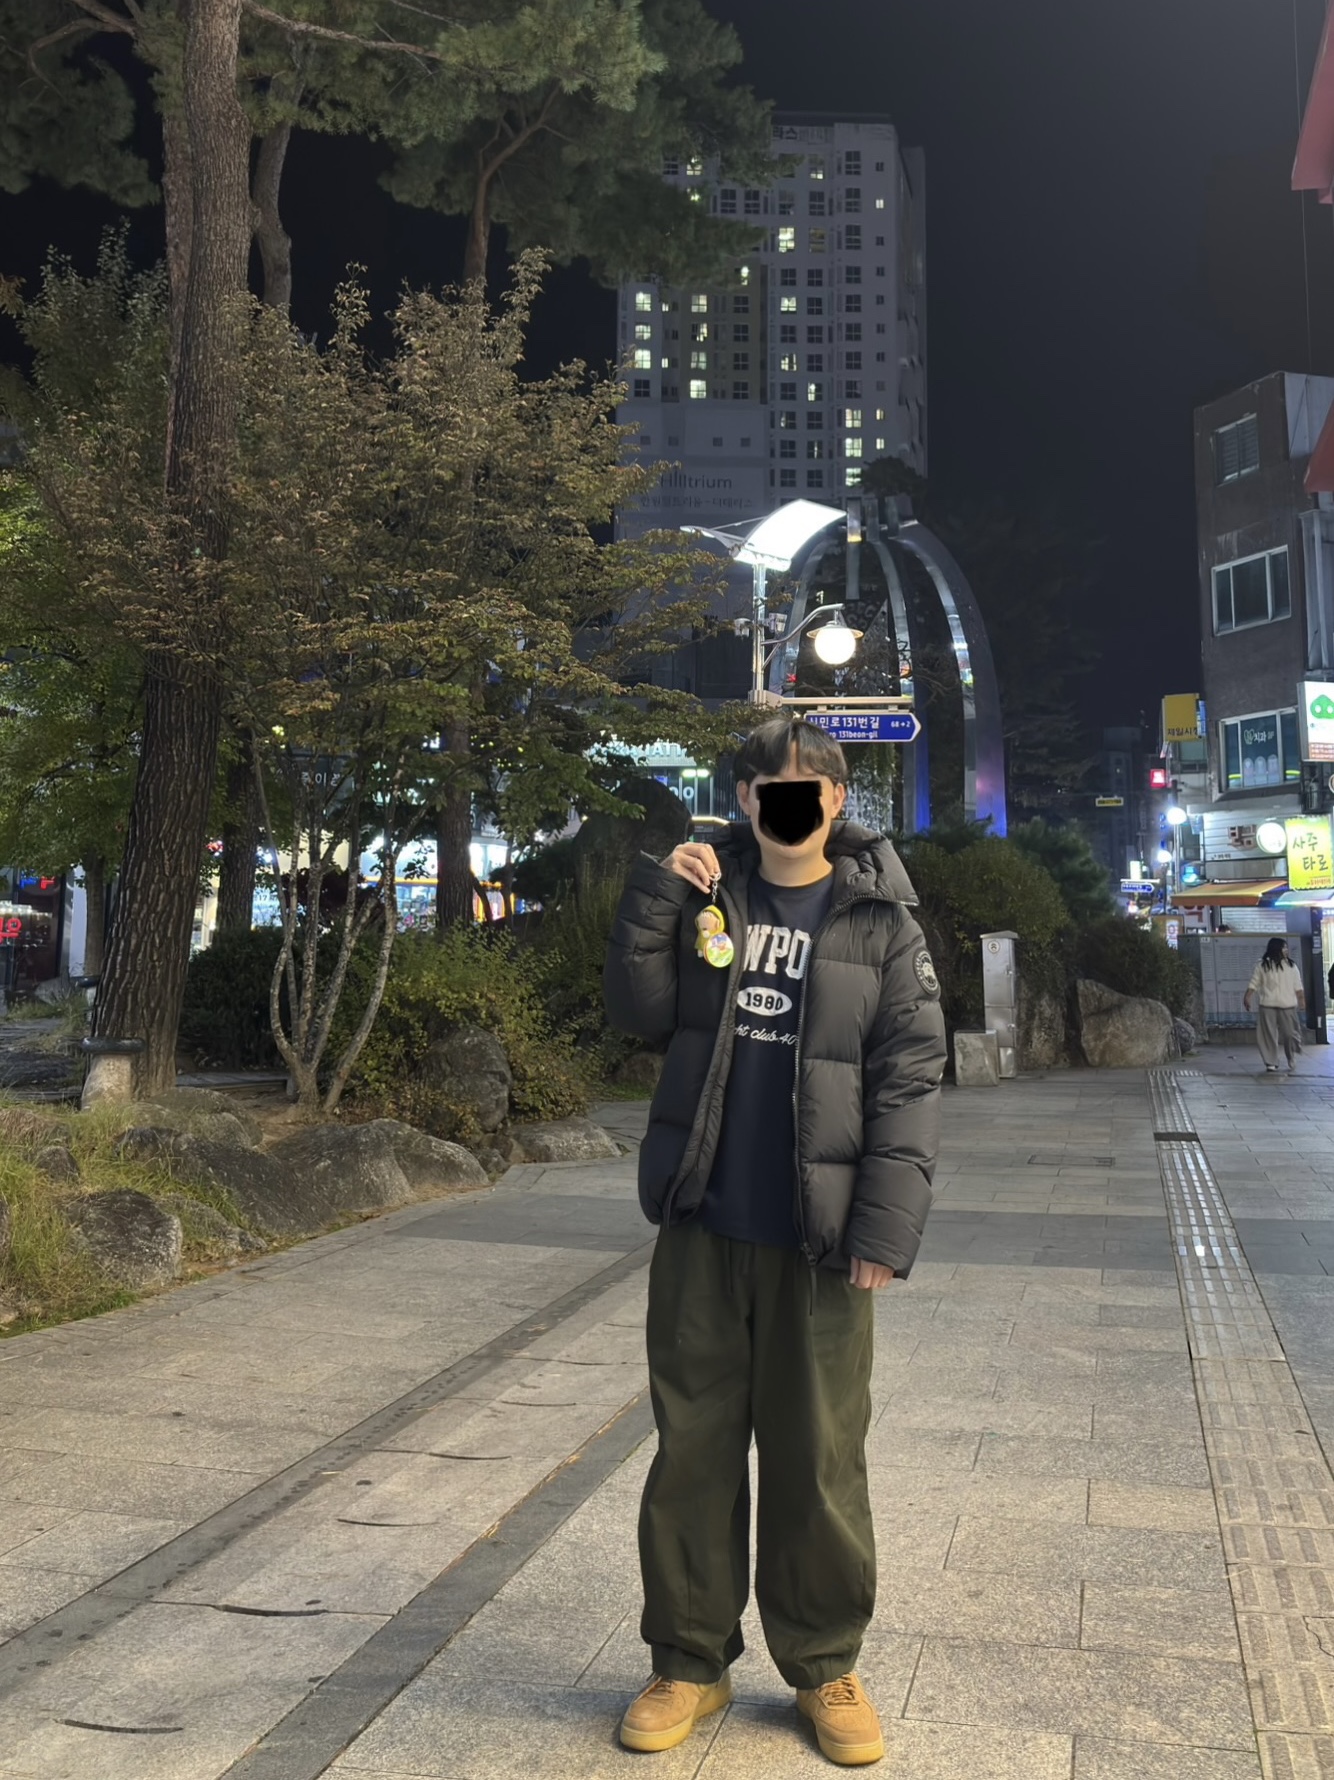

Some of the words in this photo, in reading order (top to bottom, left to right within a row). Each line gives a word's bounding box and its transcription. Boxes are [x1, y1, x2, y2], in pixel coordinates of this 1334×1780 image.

[1292, 832, 1318, 852] 사주
[1302, 854, 1329, 871] 타로
[746, 992, 783, 1011] 1980
